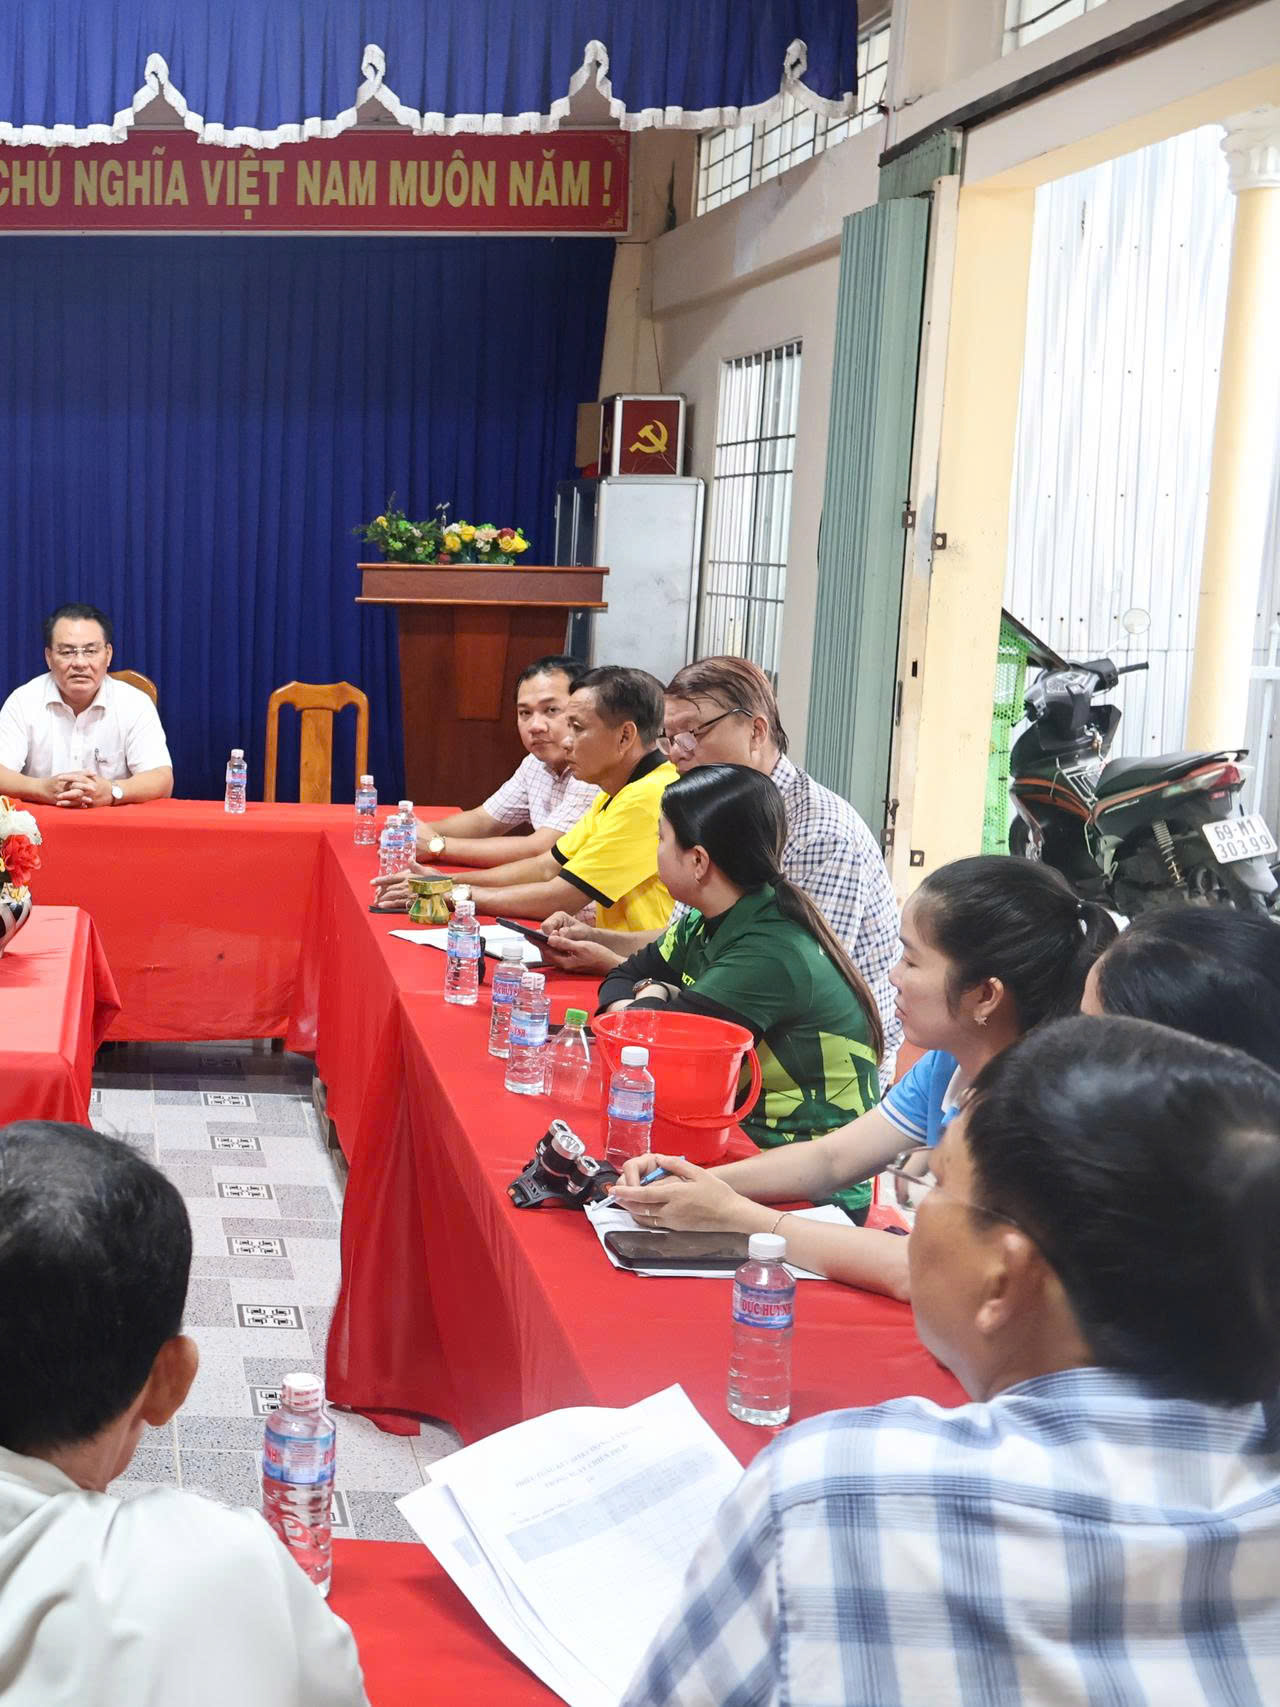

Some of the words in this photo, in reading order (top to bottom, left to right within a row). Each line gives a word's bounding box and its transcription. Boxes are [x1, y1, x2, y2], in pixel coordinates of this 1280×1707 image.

[74, 146, 189, 207] NGHĨA
[200, 149, 285, 220] VIỆT
[296, 159, 377, 206] NAM
[388, 149, 497, 208] MUÔN
[509, 149, 590, 207] NĂM
[603, 160, 612, 206] !
[1214, 819, 1257, 841] 69-M1
[1217, 834, 1271, 859] 303.99
